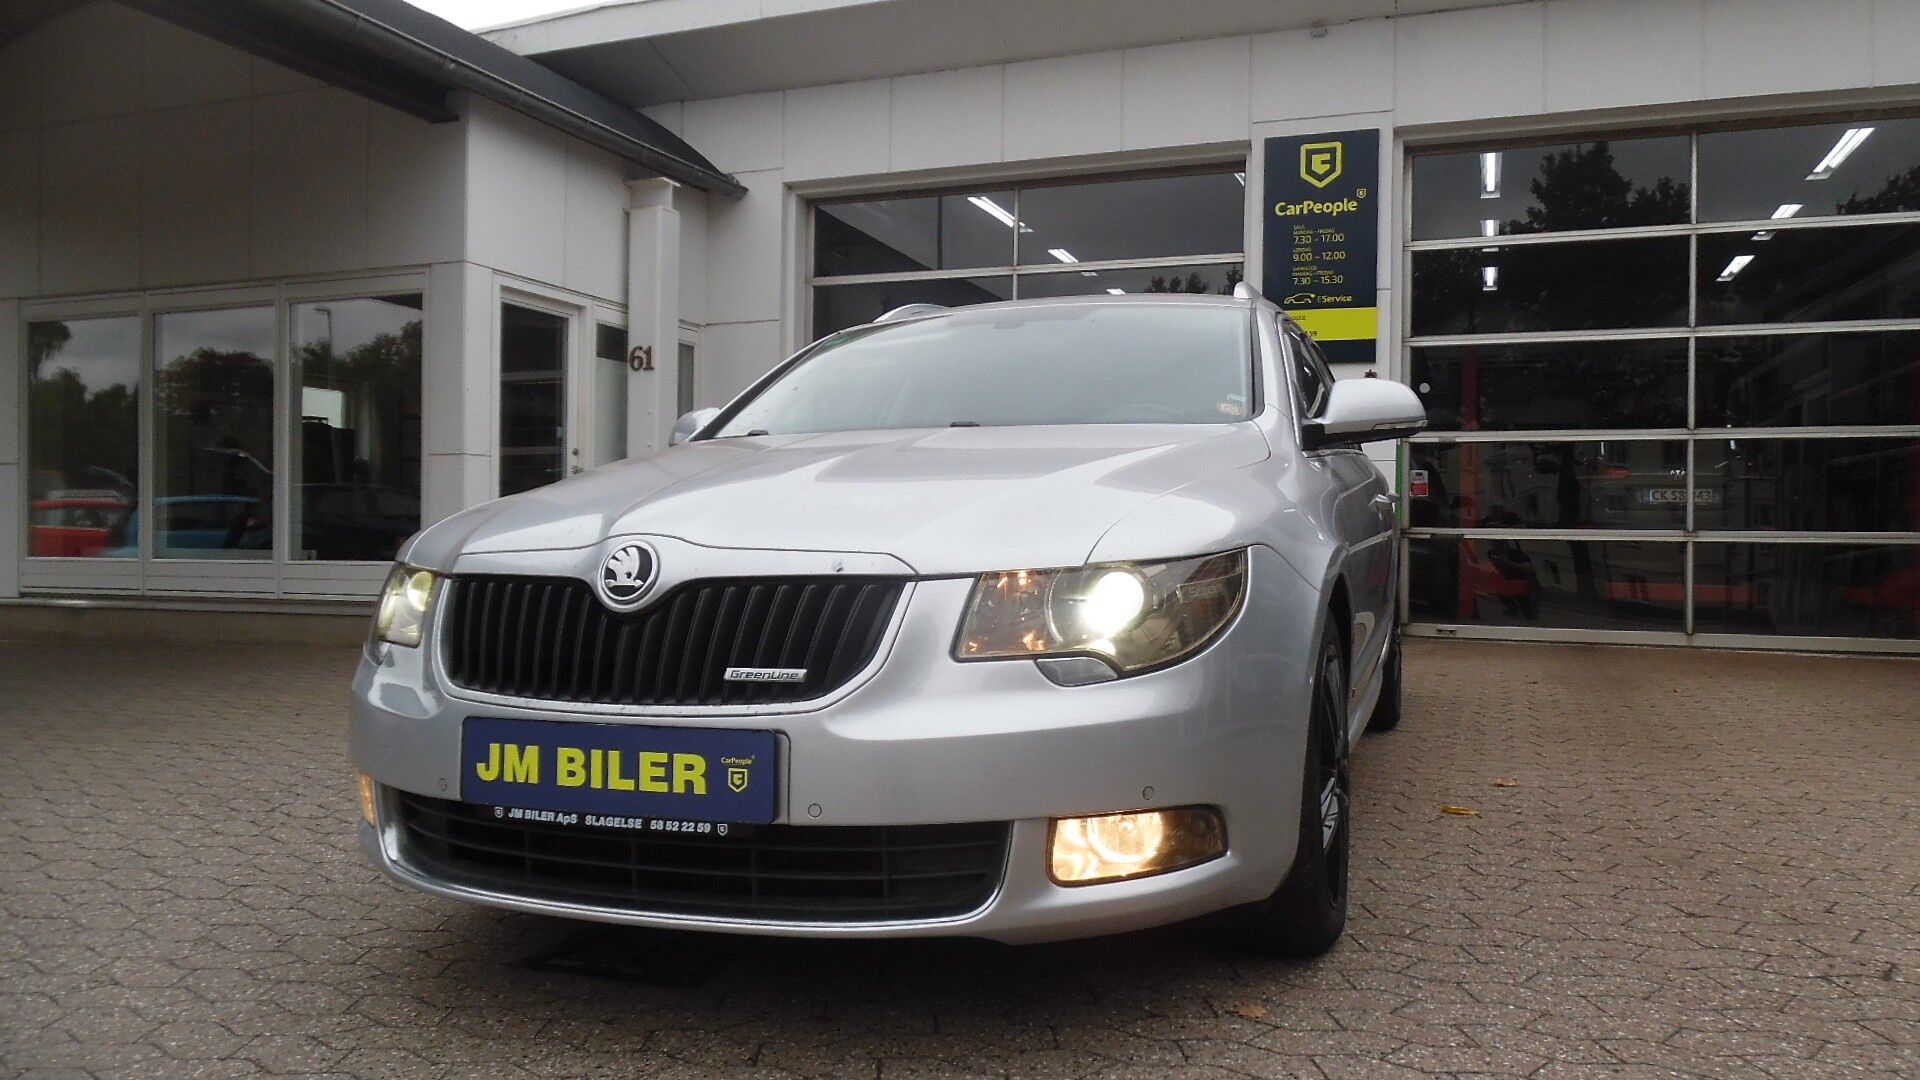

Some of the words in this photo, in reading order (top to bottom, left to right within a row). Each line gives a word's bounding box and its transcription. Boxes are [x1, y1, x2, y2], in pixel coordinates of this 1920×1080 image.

[1275, 198, 1358, 216] CarPeople
[1293, 235, 1312, 244] 7.30
[1321, 233, 1345, 242] 17.00
[1292, 253, 1313, 262] 9.00
[1322, 251, 1346, 260] 12.00
[1292, 277, 1311, 285] 7.30
[1320, 274, 1343, 284] 15.30
[629, 345, 655, 371] 61
[730, 669, 799, 680] GreenLine
[721, 756, 752, 766] CarPeople
[476, 743, 540, 785] JM
[556, 747, 708, 796] BILER
[508, 808, 523, 819] JM
[524, 809, 555, 822] BILER
[555, 812, 578, 826] ApS
[584, 815, 642, 829] SLAGELSE
[650, 820, 664, 831] 58
[665, 821, 680, 832] 52
[680, 822, 695, 832] 22
[696, 823, 711, 833] 59
